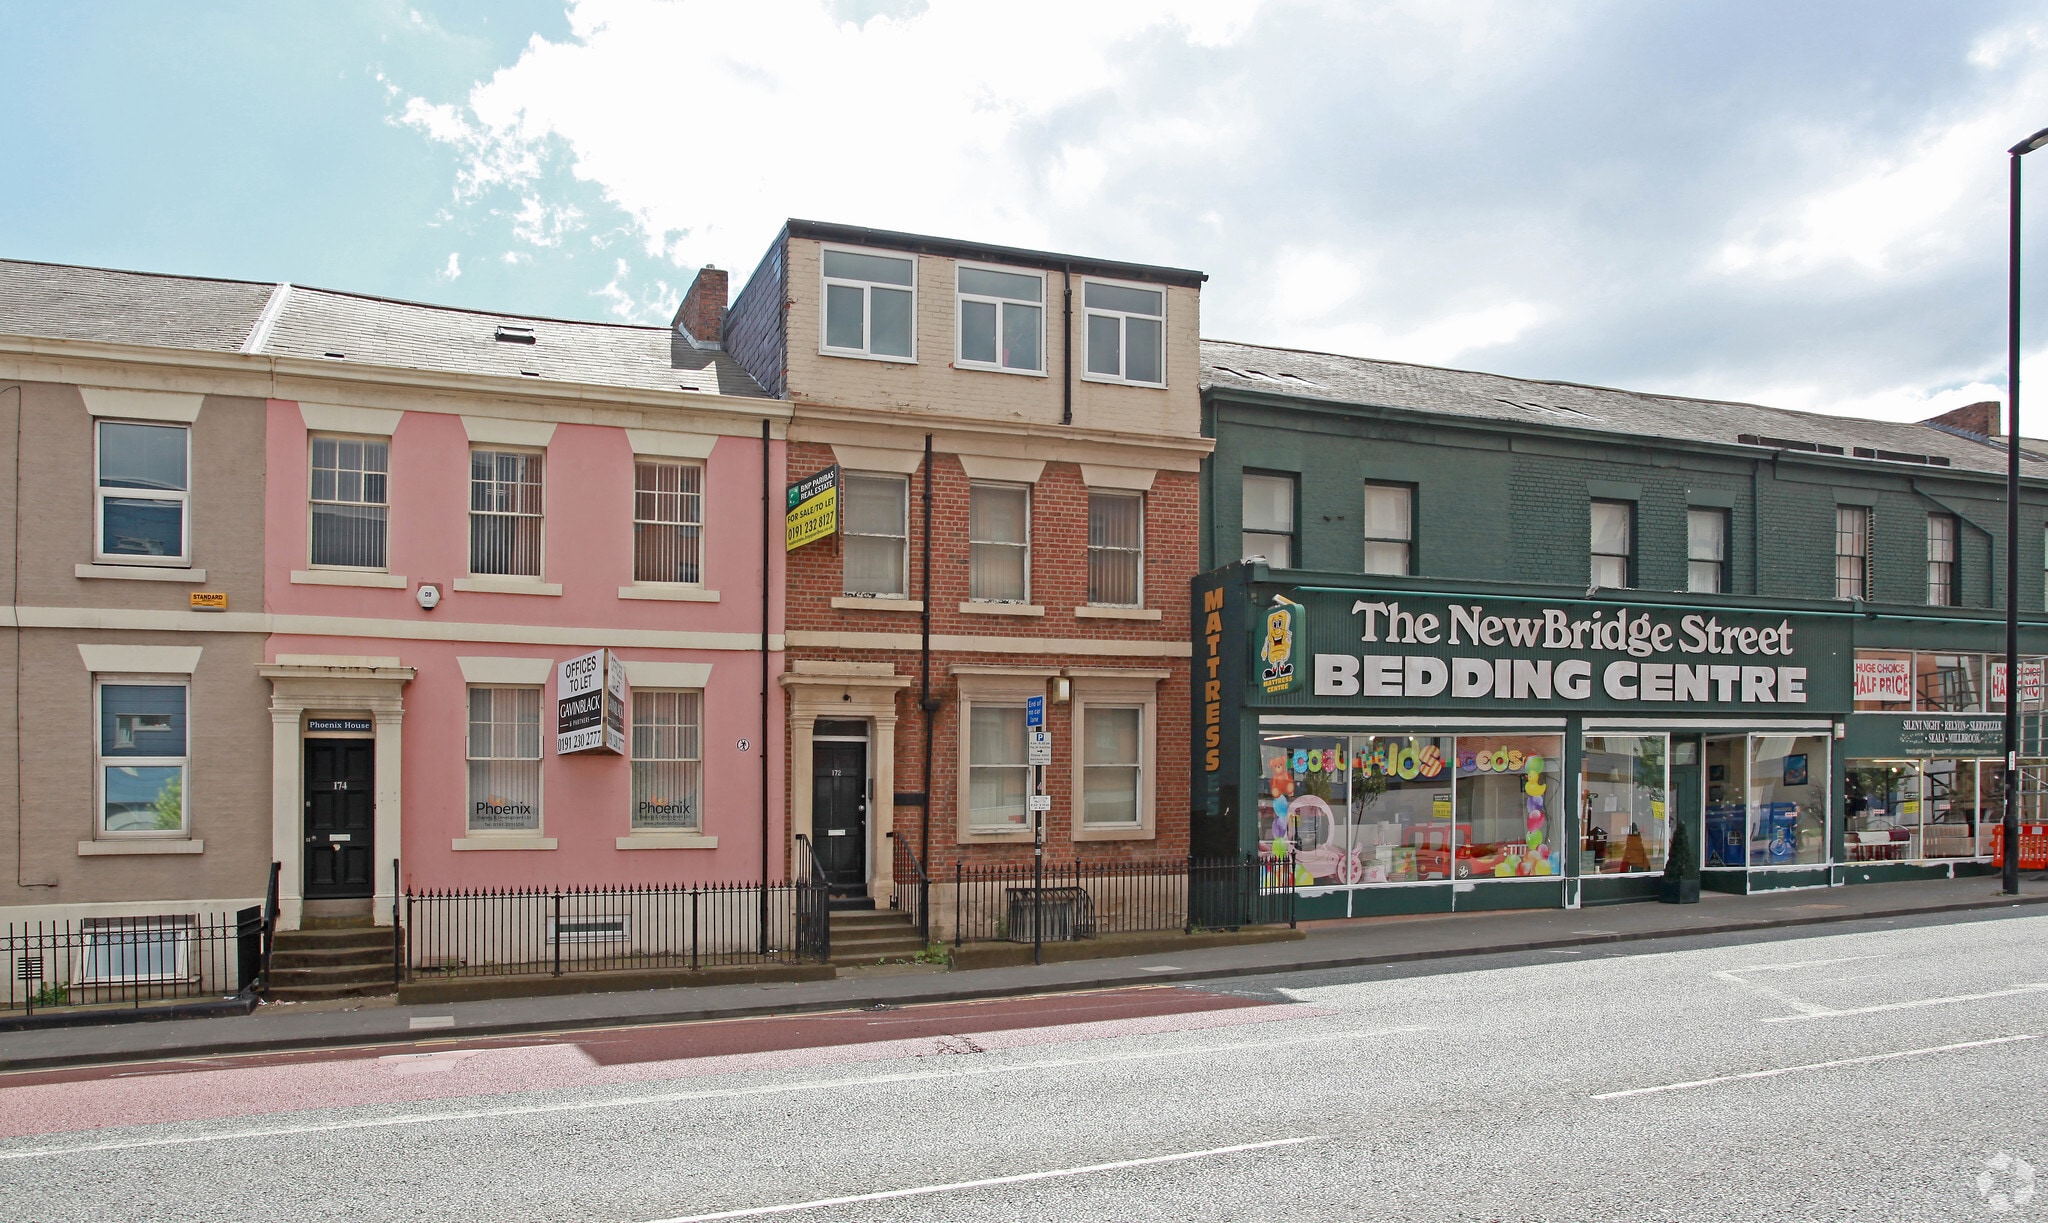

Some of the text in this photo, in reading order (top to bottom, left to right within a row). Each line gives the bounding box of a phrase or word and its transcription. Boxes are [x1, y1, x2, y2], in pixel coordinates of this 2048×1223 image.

[800, 471, 834, 493] BNP PARIBAS
[800, 480, 833, 501] REAL ESTATE
[787, 512, 799, 524] FOR
[825, 497, 834, 507] LET
[788, 511, 834, 541] 0191 232 8127
[1351, 600, 1441, 645] The
[1678, 614, 1794, 656] Street
[565, 655, 597, 679] OFFICES
[1856, 663, 1905, 673] HUGE CHOICE
[570, 674, 592, 692] TO LET
[1204, 587, 1224, 772] MATTRESS
[1263, 675, 1293, 687] MATTRESS
[1267, 683, 1289, 693] CENTRE
[1314, 653, 1807, 703] BEDDING CENTRE
[1880, 673, 1908, 696] PRICE
[1903, 720, 1923, 731] SILENT
[1923, 720, 1940, 731] NIGHT
[558, 735, 572, 752] 0191
[573, 733, 585, 749] 230
[586, 730, 601, 746] 2777
[1928, 733, 1946, 743] SEALY
[333, 782, 347, 790] 174
[476, 801, 531, 815] Phoenix
[639, 801, 690, 814] Phoenix
